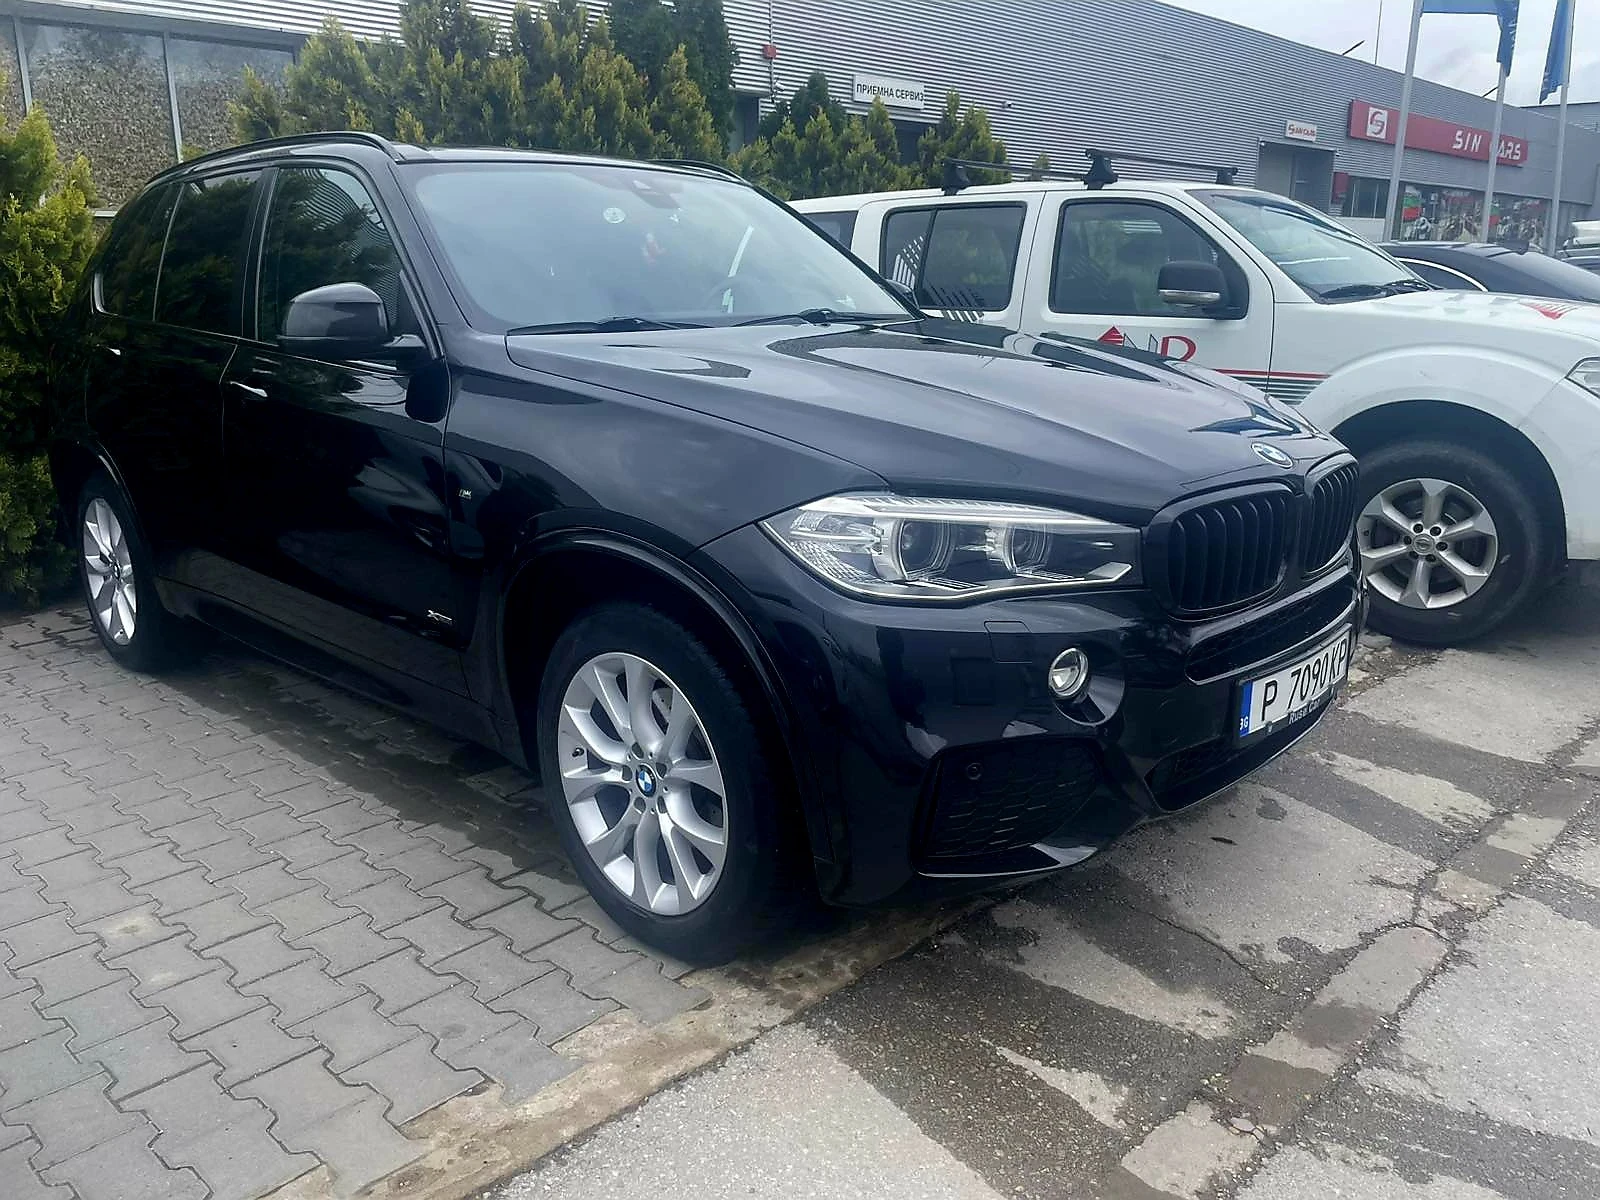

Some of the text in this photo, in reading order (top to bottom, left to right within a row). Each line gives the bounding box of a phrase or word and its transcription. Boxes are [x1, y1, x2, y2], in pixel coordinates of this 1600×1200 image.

[856, 83, 924, 102] ПРИЕМНА СЕРВИЗ
[1452, 130, 1482, 153] SIN
